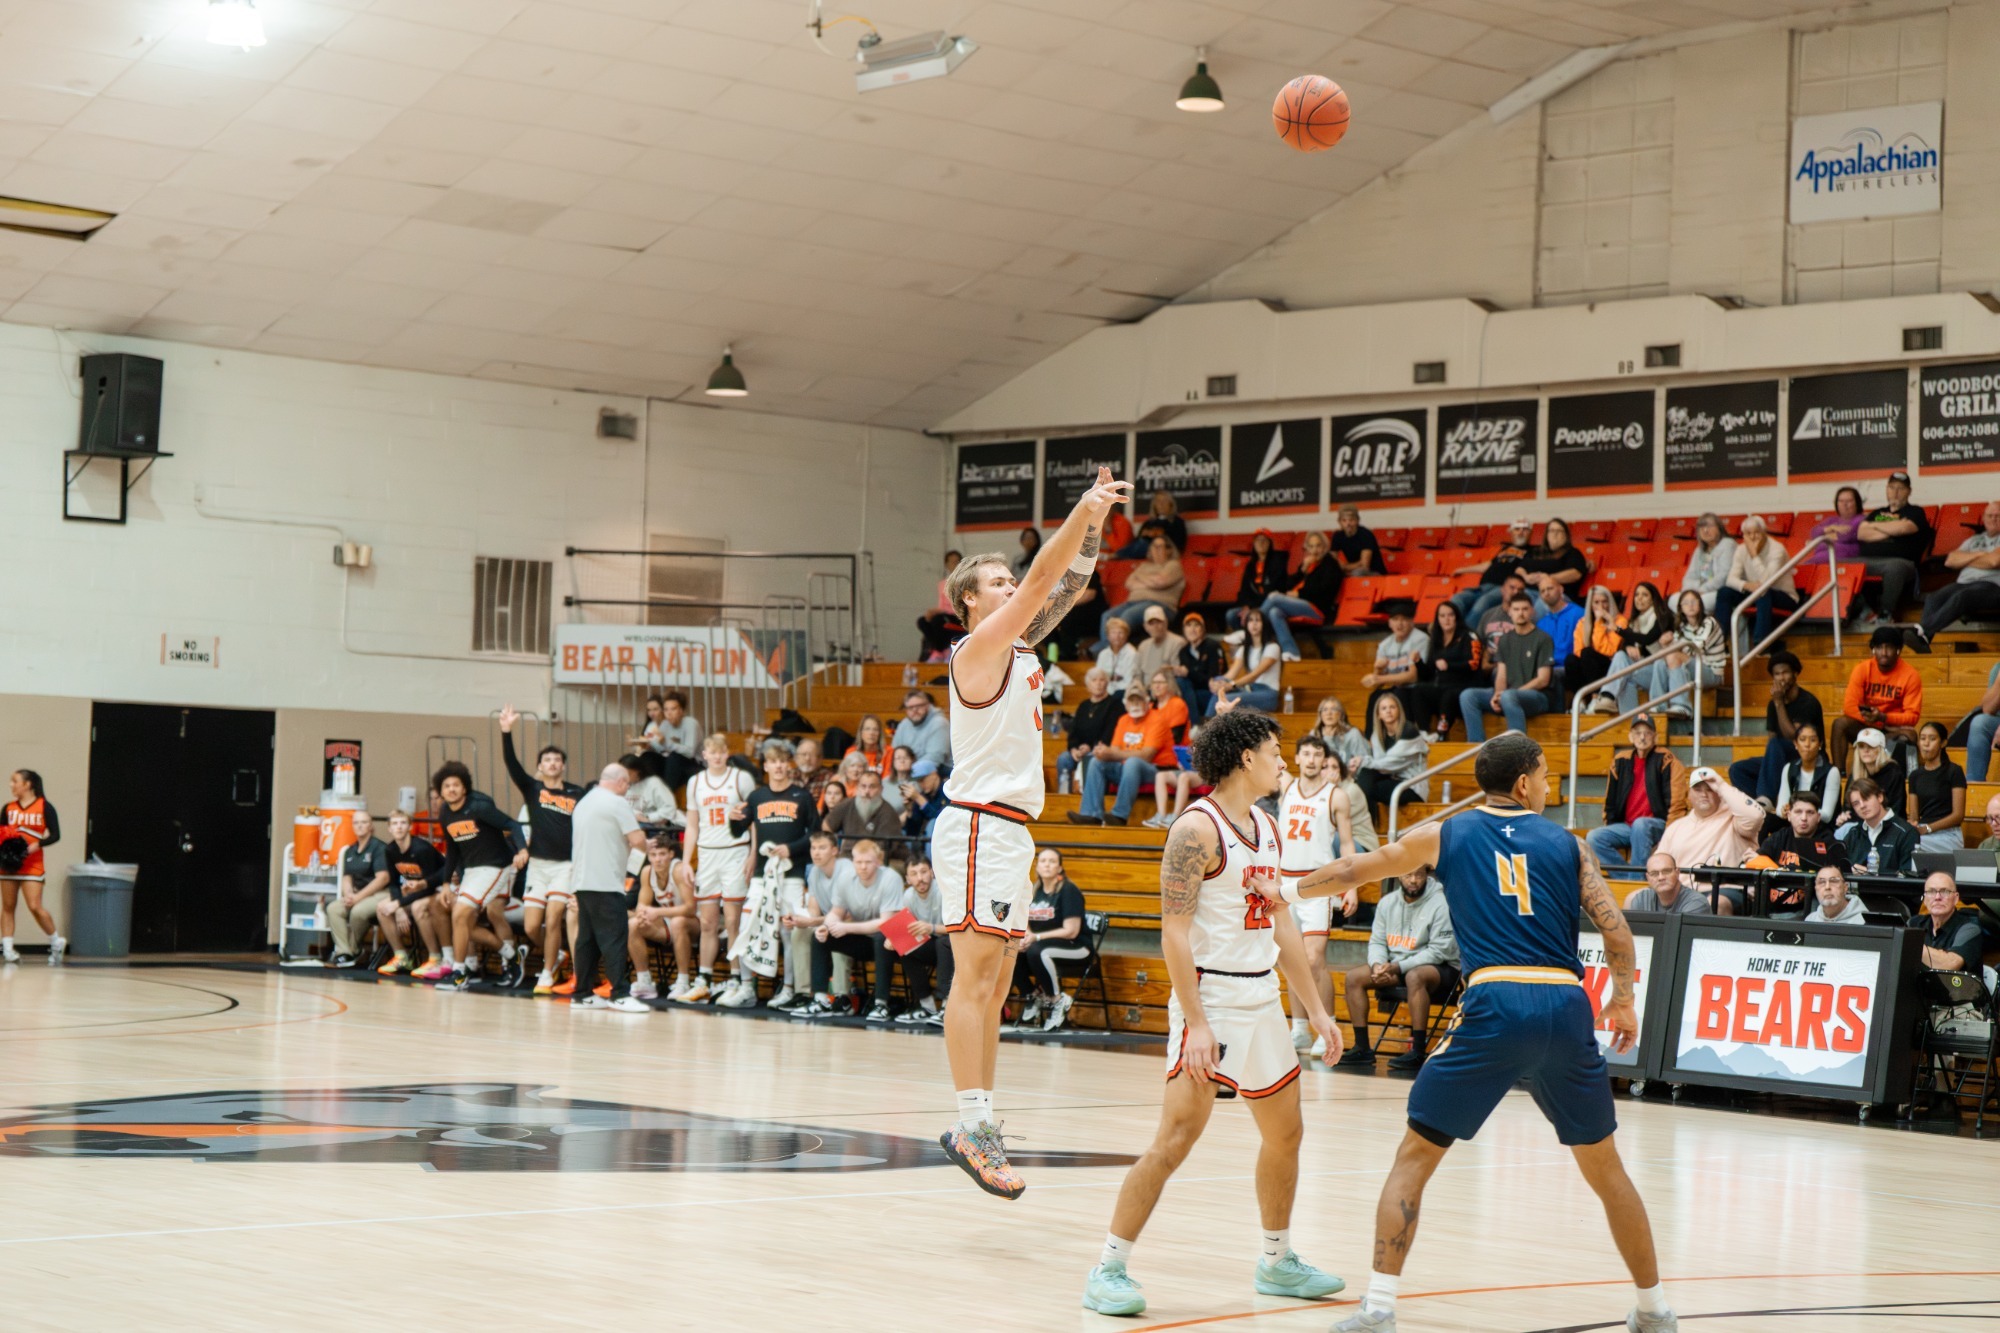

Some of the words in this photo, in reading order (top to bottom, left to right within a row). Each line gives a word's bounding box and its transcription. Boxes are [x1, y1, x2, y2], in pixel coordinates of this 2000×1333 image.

[1796, 142, 1937, 193] Appalachian
[1836, 173, 1937, 192] WIRELESS
[1823, 402, 1901, 421] Community
[1446, 418, 1525, 443] JADED
[1554, 425, 1622, 447] Peoples
[1823, 422, 1857, 438] Trust
[1862, 417, 1896, 435] Bank
[1333, 441, 1409, 478] C.O.R.E
[1440, 440, 1520, 465] RAYNE
[1265, 487, 1305, 504] SPORTS
[183, 640, 197, 650] NO
[169, 651, 210, 663] SMOKING
[562, 644, 634, 672] BEAR
[647, 646, 747, 675] NATION
[8, 810, 43, 826] UPIKE
[709, 807, 726, 826] 15
[757, 801, 798, 820] UPIKE
[1289, 804, 1317, 818] UPIKE
[1287, 818, 1312, 842] 24
[1494, 850, 1535, 916] 4
[1747, 957, 1781, 973] HOME
[1783, 960, 1799, 975] OF
[1803, 961, 1827, 977] THE
[1695, 973, 1871, 1054] BEARS
